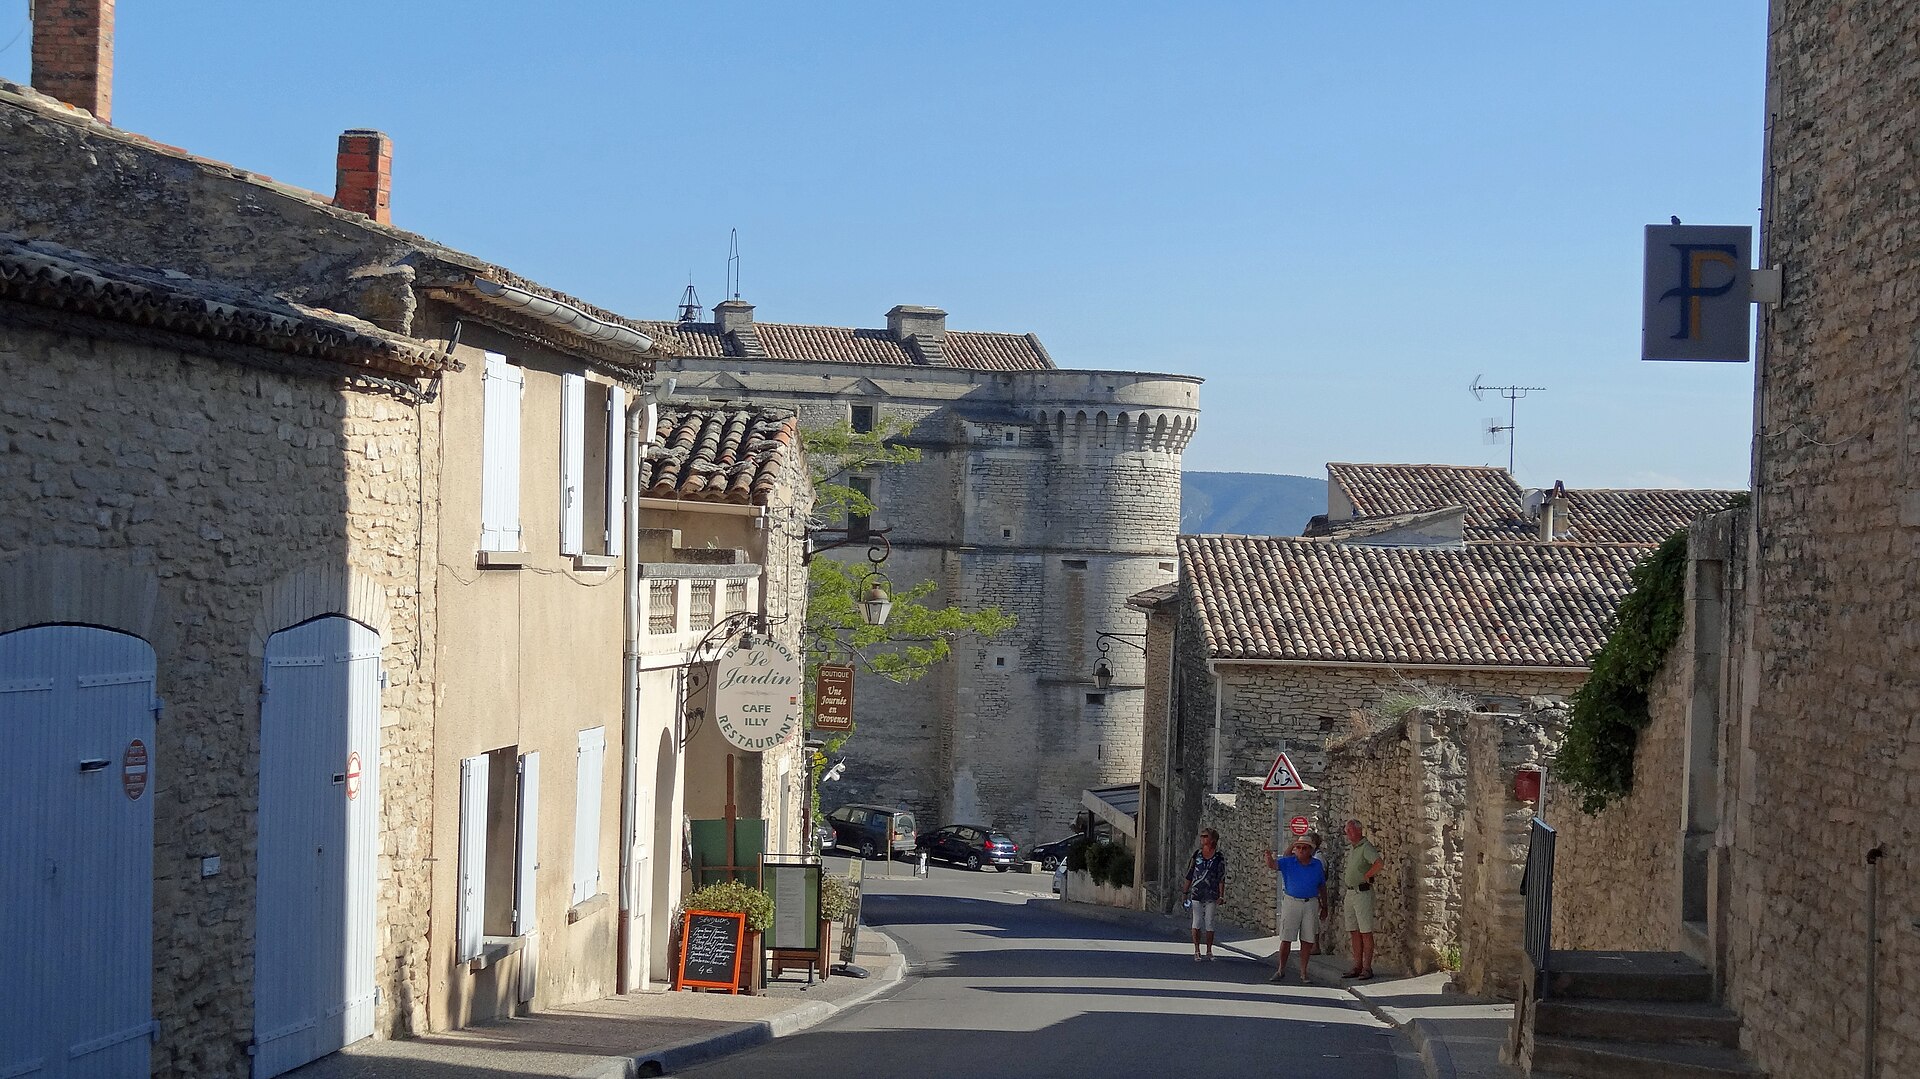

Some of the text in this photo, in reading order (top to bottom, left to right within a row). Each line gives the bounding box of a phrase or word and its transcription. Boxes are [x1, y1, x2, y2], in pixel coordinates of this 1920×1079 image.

[726, 637, 793, 662] DERATION
[744, 650, 770, 667] Le
[719, 666, 794, 690] Jardin
[827, 685, 842, 696] Une
[820, 695, 847, 706] Journée
[742, 704, 772, 713] CAFE
[828, 706, 837, 714] en
[744, 717, 769, 726] ILLY
[817, 713, 848, 724] Provence
[718, 714, 794, 748] RESTAURANT
